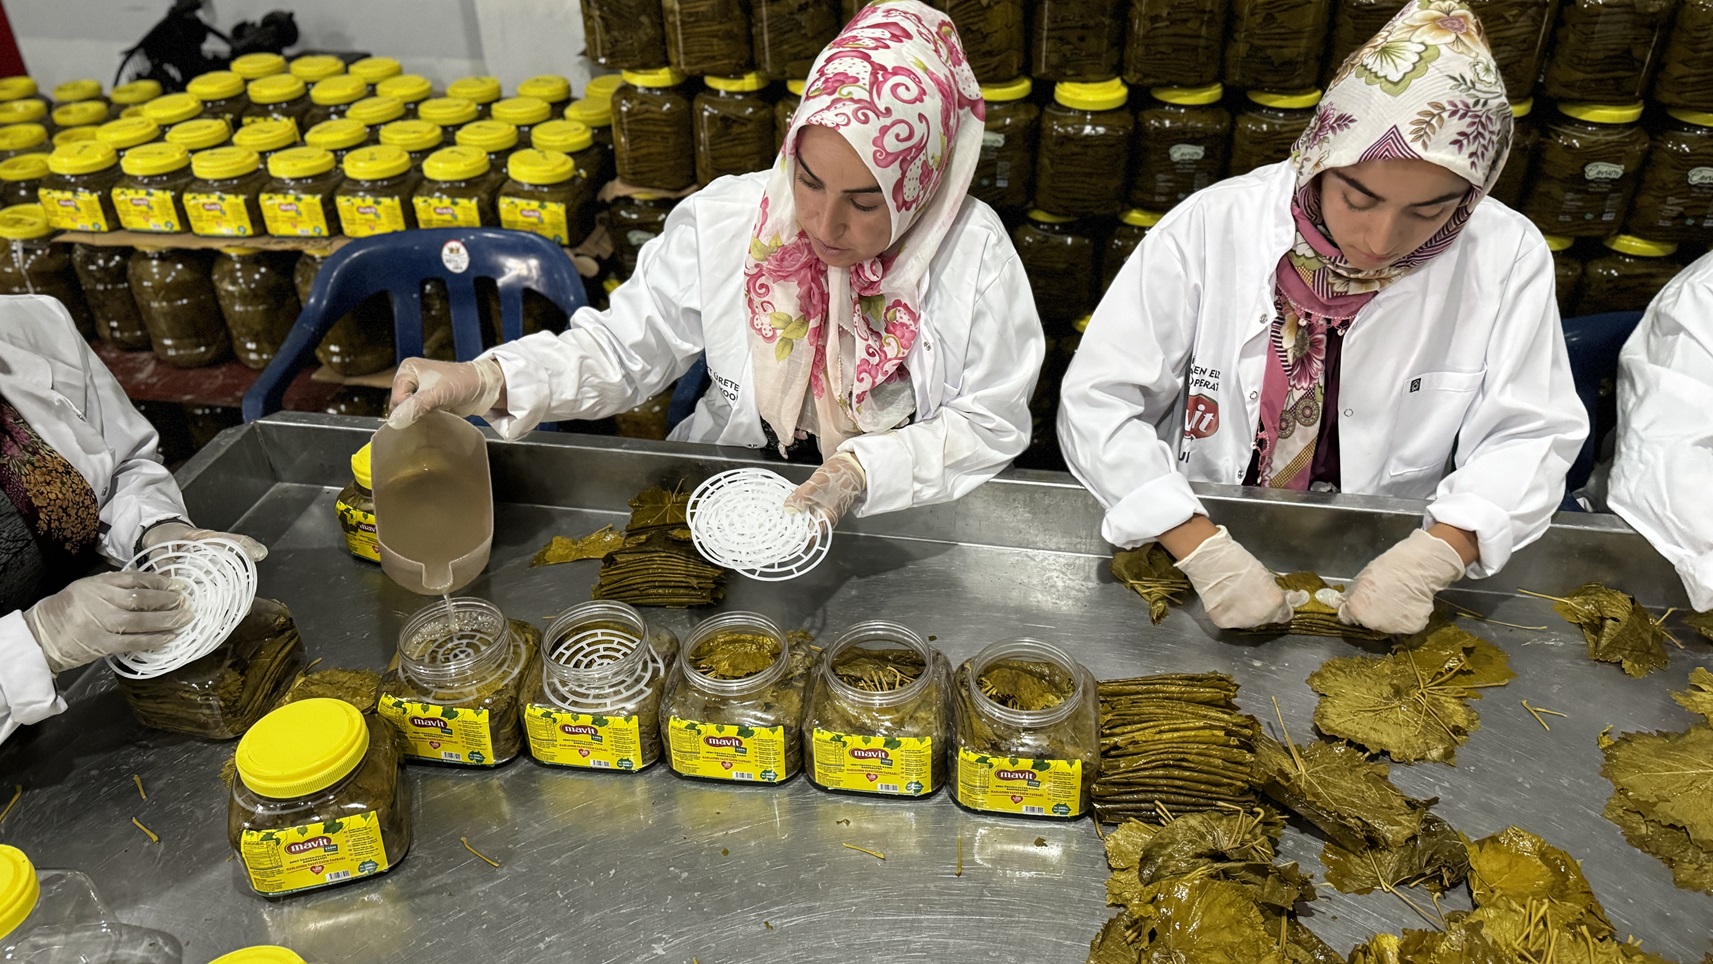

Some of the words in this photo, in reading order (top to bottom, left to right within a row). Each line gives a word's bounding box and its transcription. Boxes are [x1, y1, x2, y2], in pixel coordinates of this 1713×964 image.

[414, 718, 445, 728] mavit
[564, 725, 596, 735] mavit
[708, 738, 740, 747] mavit
[854, 750, 886, 759] mavit
[1000, 771, 1033, 780] mavit
[291, 838, 328, 852] mavit
